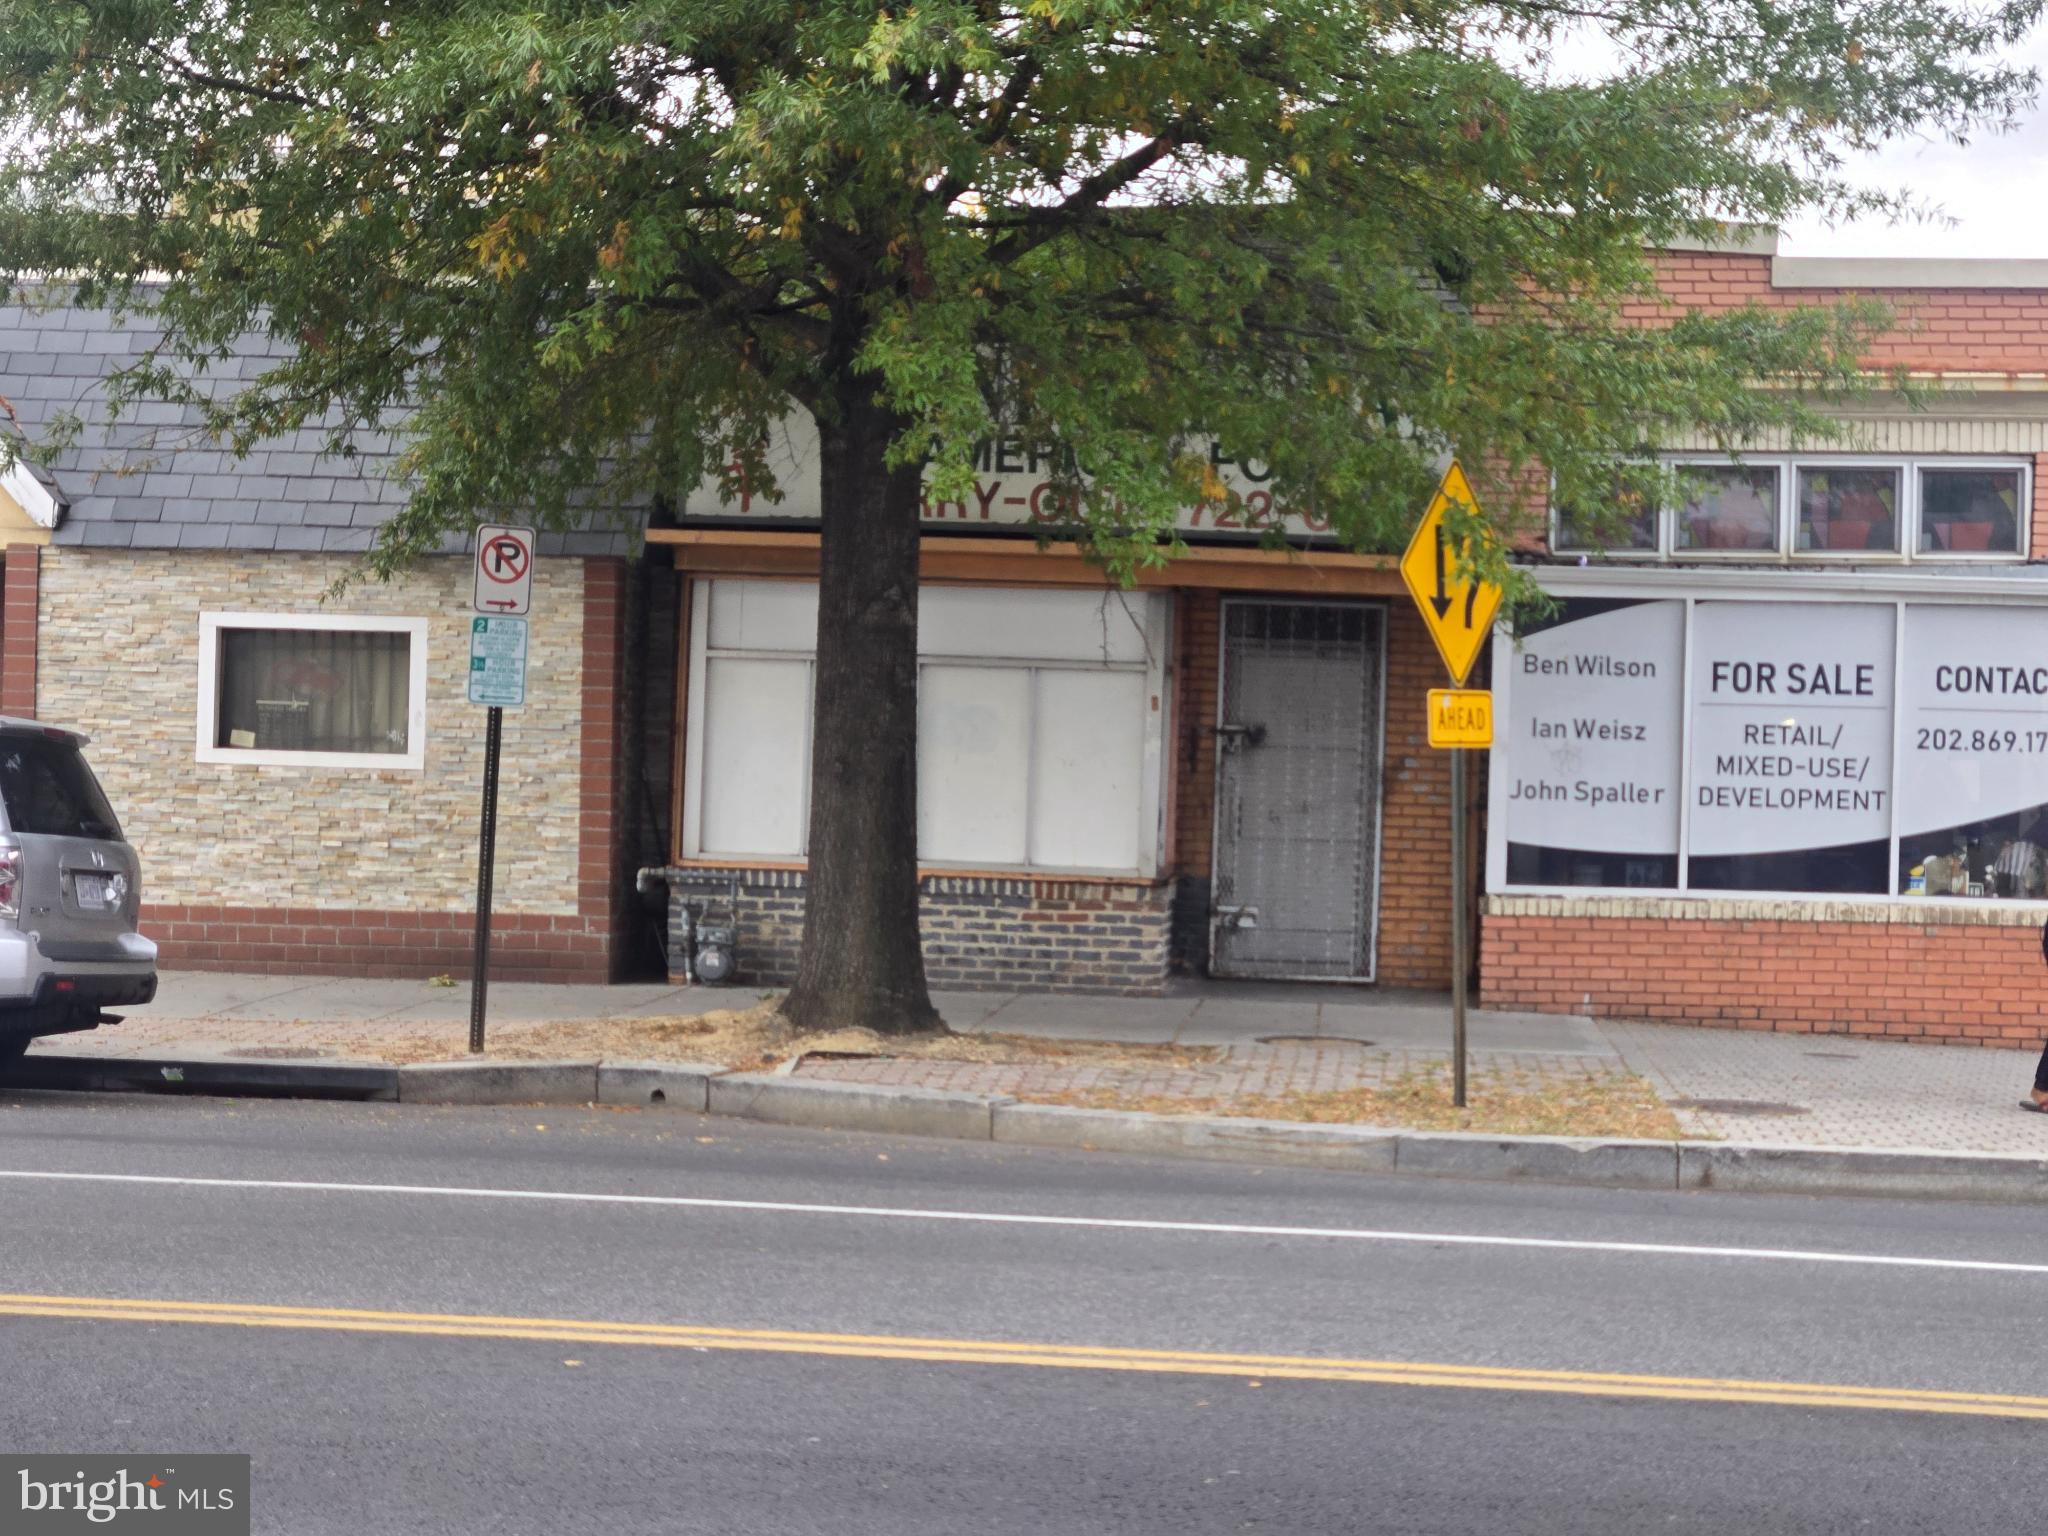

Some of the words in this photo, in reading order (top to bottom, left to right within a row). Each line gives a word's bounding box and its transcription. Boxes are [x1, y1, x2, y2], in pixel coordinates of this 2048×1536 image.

[494, 542, 521, 573] P
[476, 619, 486, 632] 2
[1523, 653, 1568, 676] Ben
[1575, 655, 1657, 678] Wilson
[1712, 661, 1776, 694] FOR
[1787, 663, 1875, 696] SALE
[1936, 665, 2048, 695] CONTAC
[1438, 706, 1486, 730] AHEAD
[1531, 718, 1566, 739] Ian
[1573, 719, 1646, 741] Weisz
[1744, 723, 1844, 750] RETAIL/
[1917, 728, 2048, 752] 202.869.17
[1716, 756, 1870, 782] MIXED-USE/
[1509, 779, 1567, 801] John
[1575, 780, 1665, 806] Spaller
[1698, 787, 1887, 811] DEVELOPMENT
